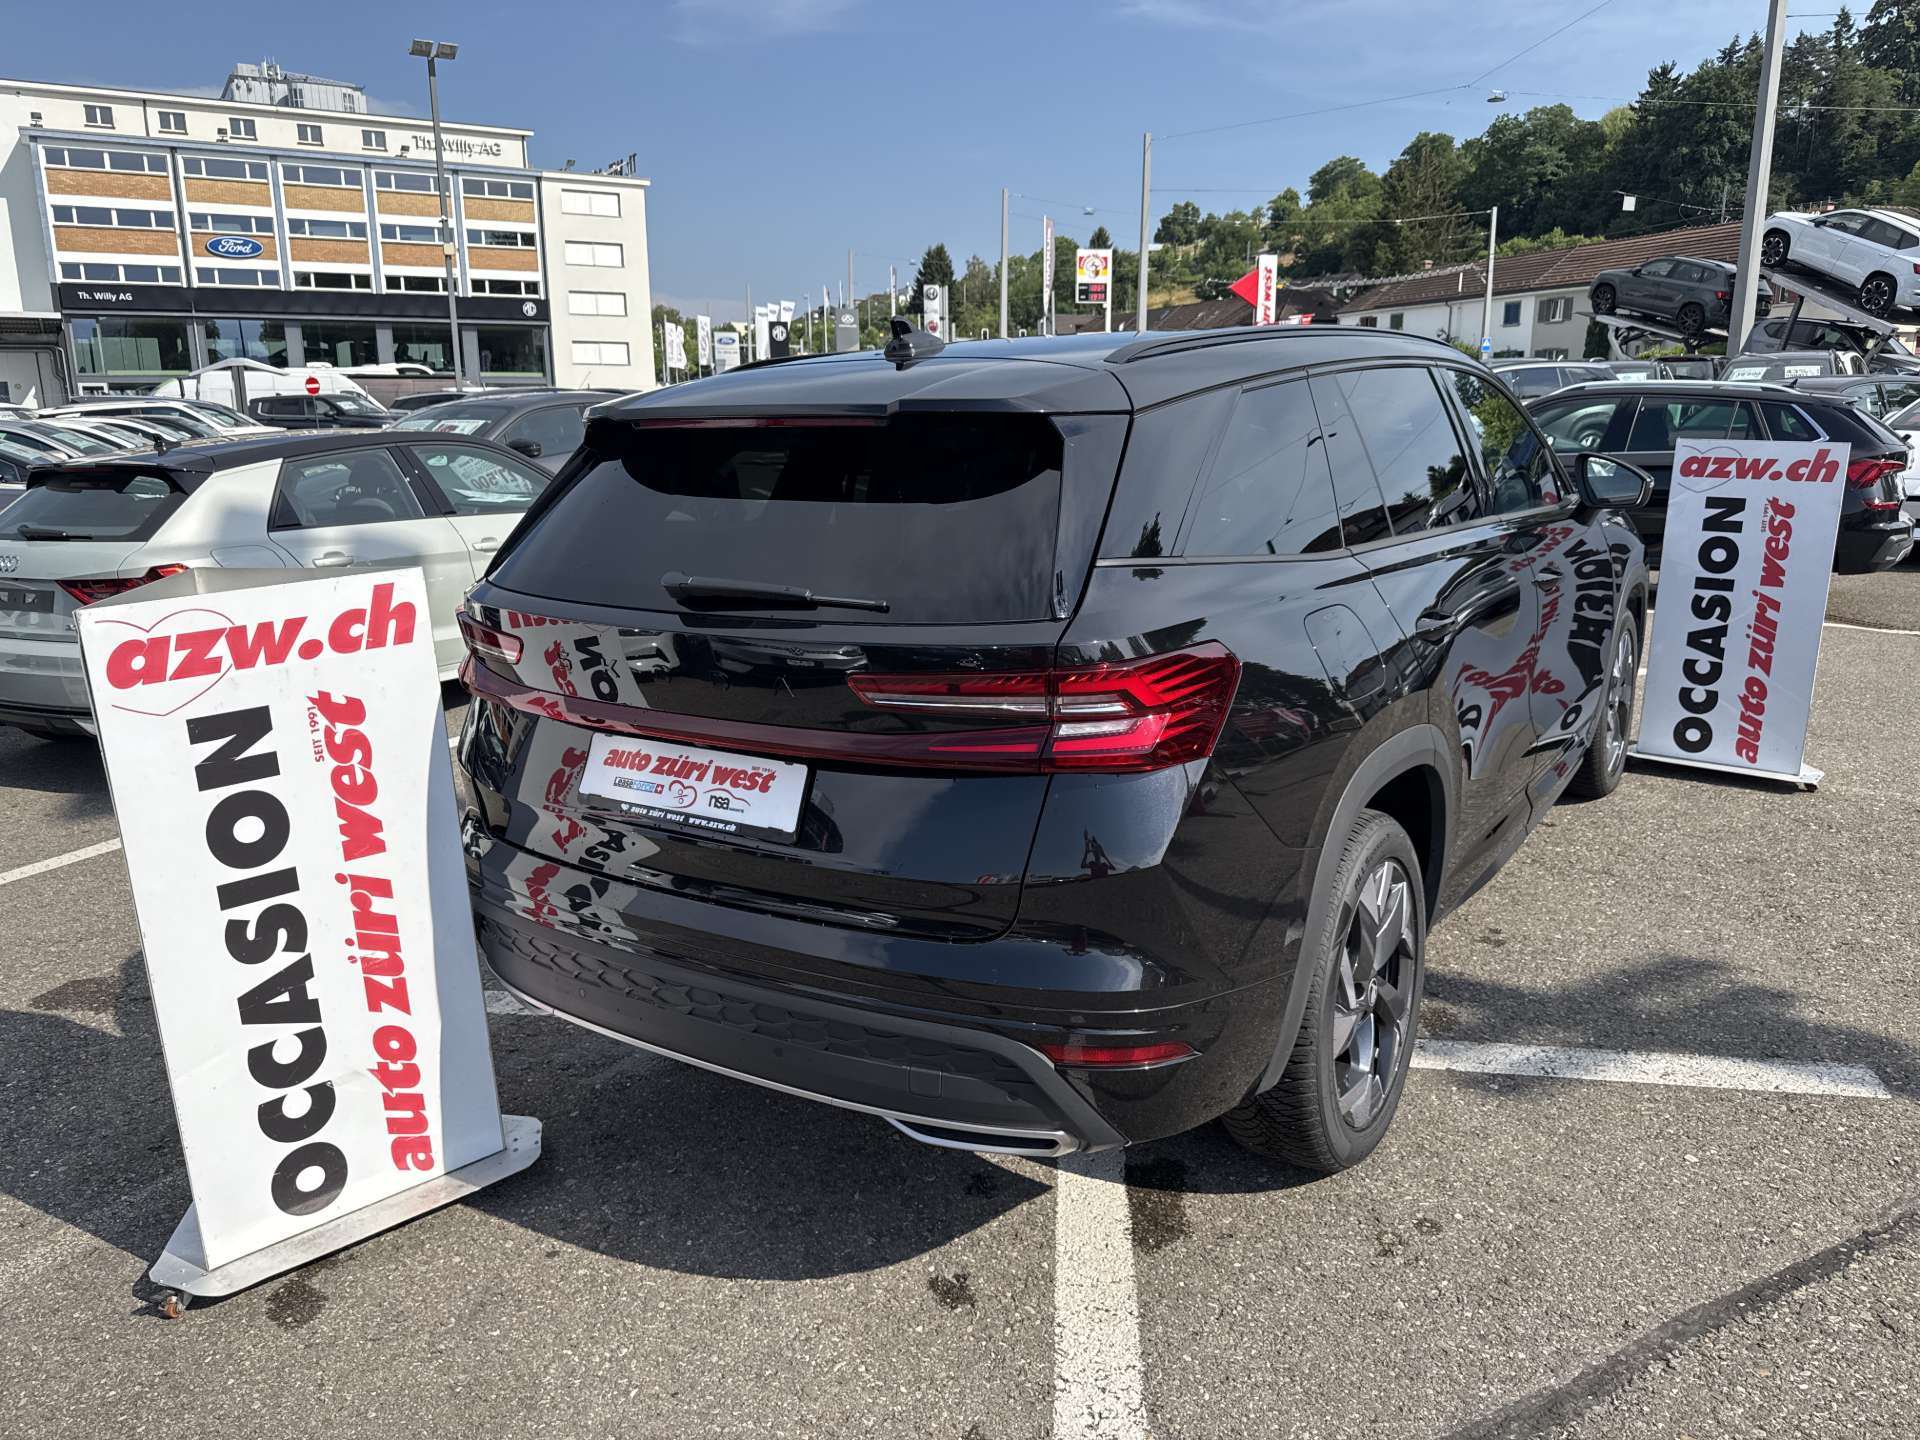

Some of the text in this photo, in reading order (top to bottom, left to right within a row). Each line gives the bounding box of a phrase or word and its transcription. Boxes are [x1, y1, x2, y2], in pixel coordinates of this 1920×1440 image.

[480, 142, 501, 156] AG
[218, 238, 253, 254] Ford
[77, 291, 132, 302] Th. Willy AG
[1680, 449, 1840, 482] azw.ch
[106, 582, 417, 690] azw.ch
[1673, 496, 1747, 753] OCCASION
[1735, 496, 1796, 765] auto züri west
[307, 706, 325, 763] SEIT 1991
[603, 748, 777, 794] auto züri west
[630, 806, 736, 832] auto züri west www.azw.ch
[708, 794, 730, 810] nsa
[306, 690, 435, 1172] auto züri west
[185, 705, 349, 1217] OCCASION
